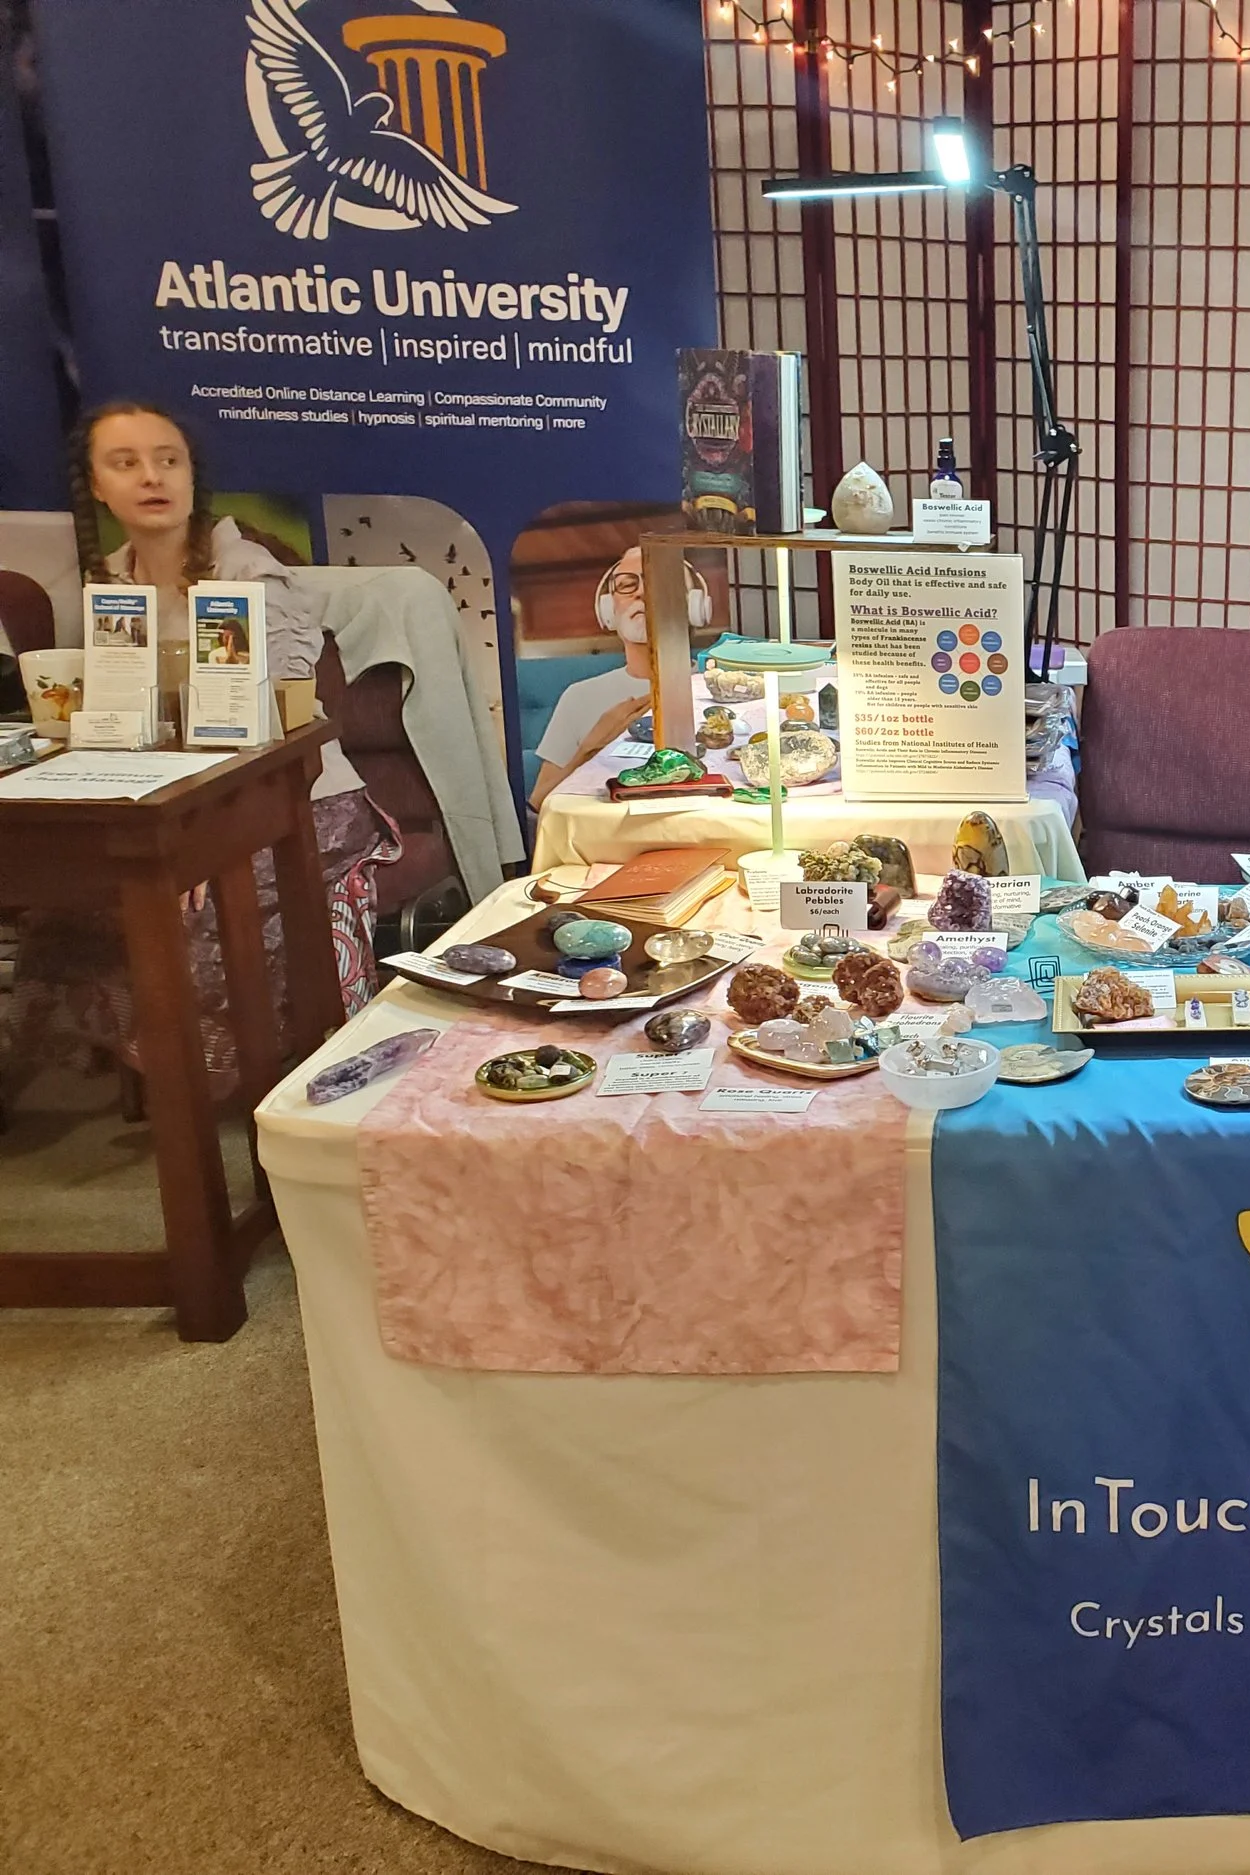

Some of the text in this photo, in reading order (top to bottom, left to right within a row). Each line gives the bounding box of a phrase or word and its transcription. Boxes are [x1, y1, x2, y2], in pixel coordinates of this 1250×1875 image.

[156, 260, 629, 333] Atlantic University
[159, 326, 633, 365] transformative inspired mindful
[191, 384, 608, 412] Accredited Online Distance Learning Compassionate Community
[219, 407, 586, 430] mindfulness studies hypnosis spiritual mentoring more
[922, 503, 983, 512] Boswellic Acid
[849, 565, 987, 577] Boswellic Acid Infusions
[849, 578, 873, 587] Body
[876, 579, 890, 587] Oil
[892, 579, 913, 587] that
[925, 580, 966, 589] effective
[968, 581, 986, 589] and
[987, 582, 1008, 590] safe
[849, 589, 864, 597] for
[866, 589, 890, 599] daily
[850, 605, 998, 619] What is Boswellic Acid?
[855, 714, 934, 723] $35/1oz bottle
[855, 727, 935, 737] $60/2oz bottle
[795, 886, 854, 895] Labradorite
[1118, 880, 1155, 889] Amber
[805, 897, 844, 905] Pebbles
[1132, 912, 1172, 934] Peach Orange
[1131, 922, 1158, 938] Selenite
[936, 935, 996, 944] Amethyst
[1070, 1595, 1245, 1649] Crystals
